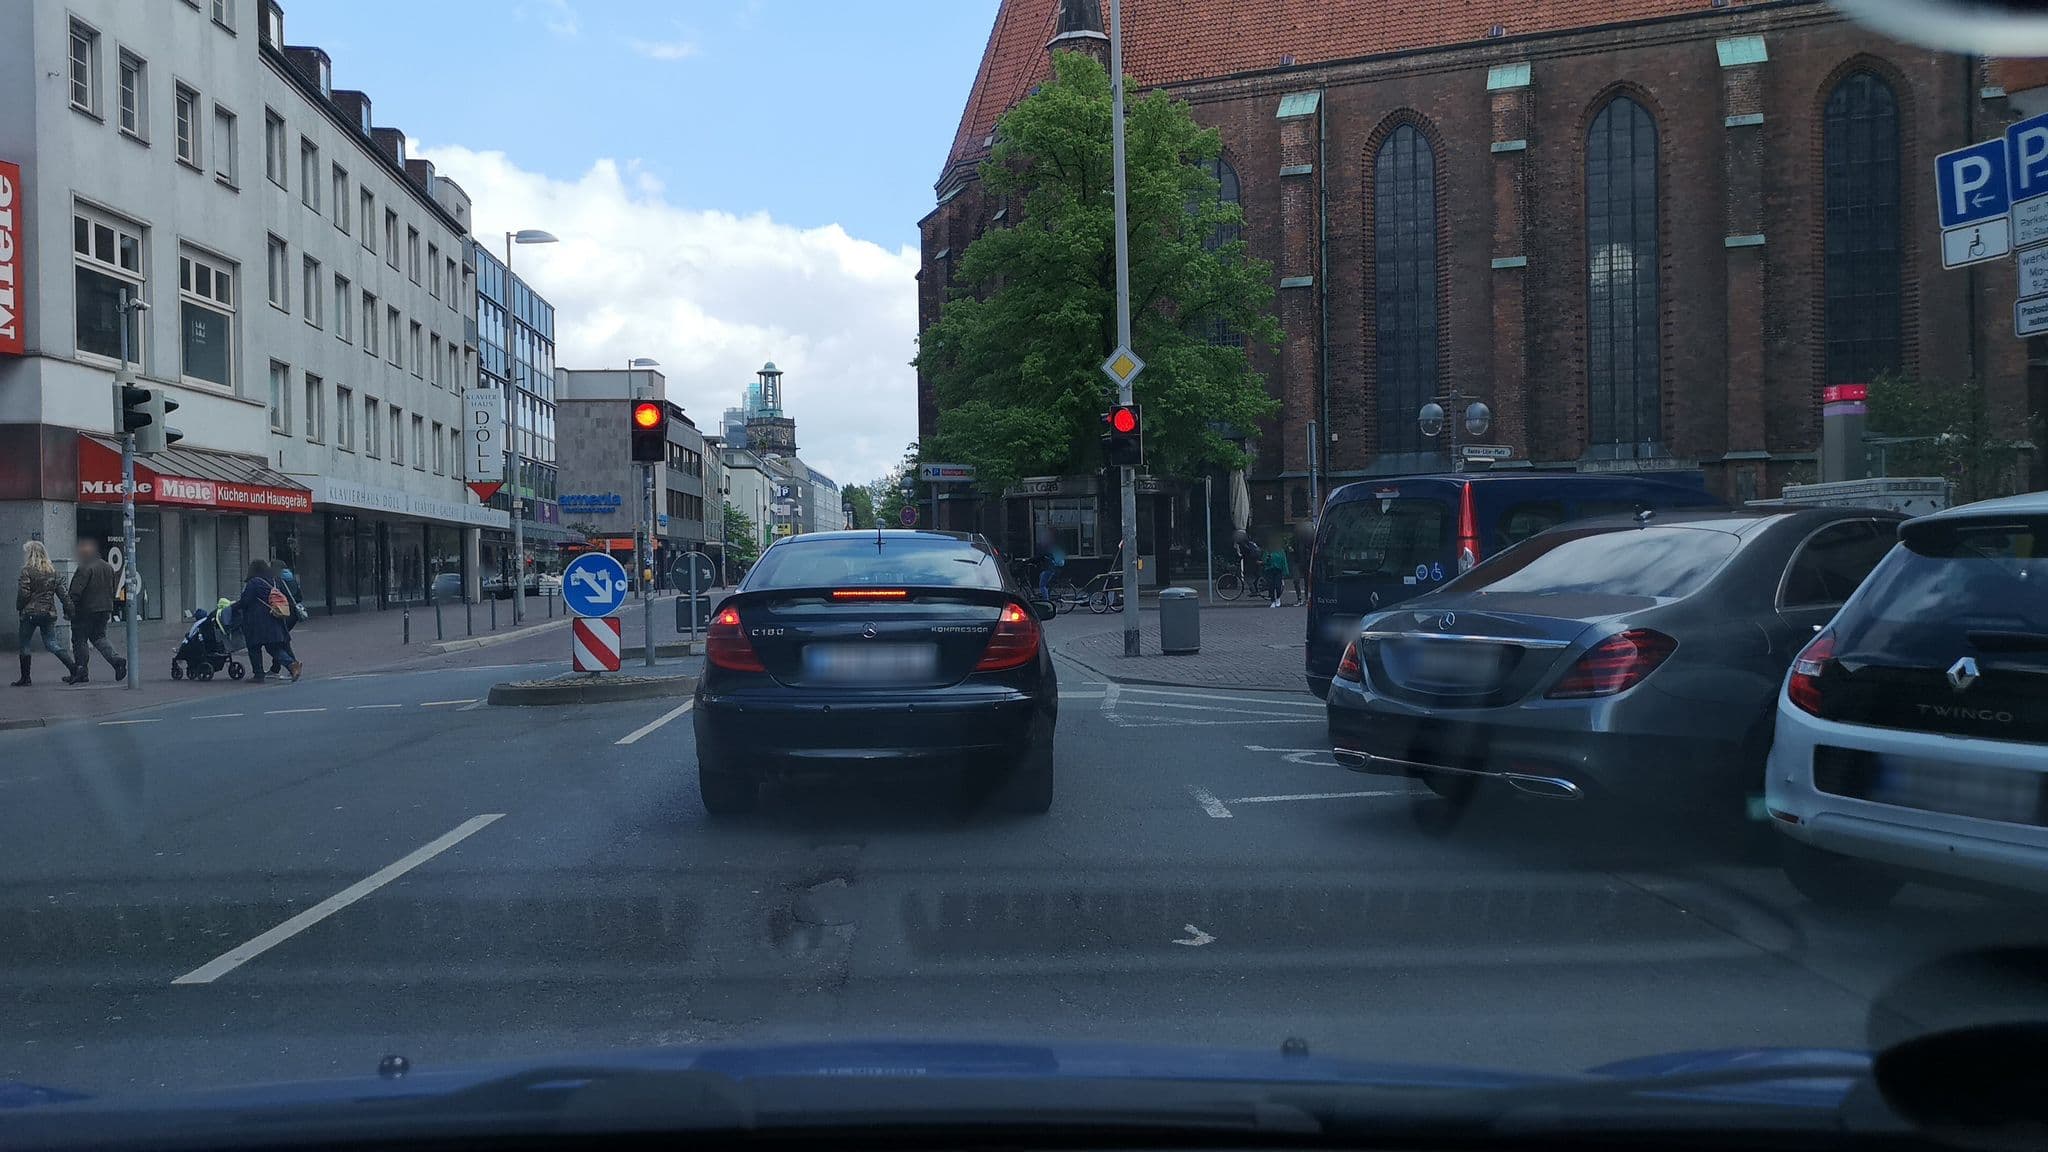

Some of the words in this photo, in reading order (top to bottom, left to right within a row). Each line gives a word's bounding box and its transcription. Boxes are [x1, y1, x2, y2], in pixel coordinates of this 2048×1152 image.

[2018, 127, 2048, 189] P
[1953, 156, 1990, 215] P
[475, 410, 491, 473] DÖLL
[162, 479, 211, 501] Miele
[217, 486, 249, 503] Küchen
[250, 492, 266, 504] und
[266, 492, 308, 508] Hausgeräte
[931, 625, 989, 633] KOMPRESSOR
[1917, 703, 2014, 722] TWINGO
